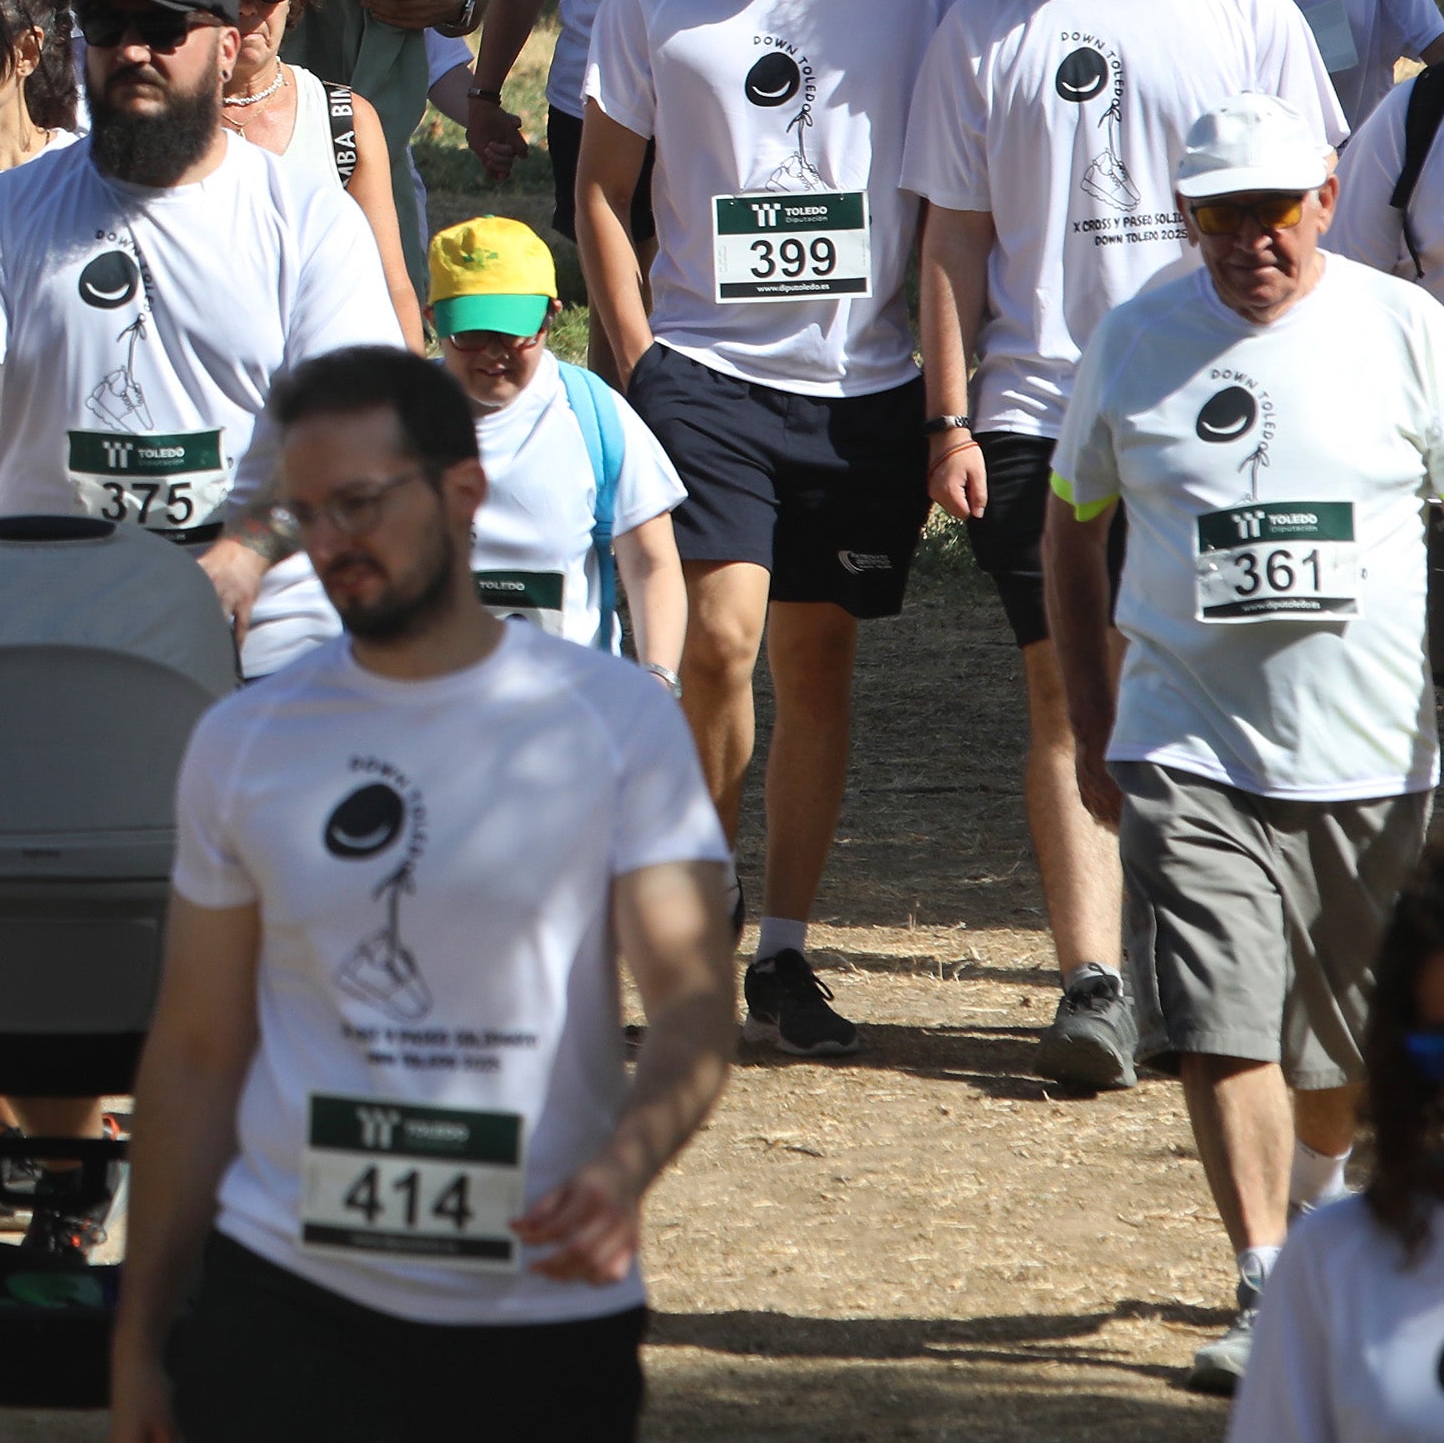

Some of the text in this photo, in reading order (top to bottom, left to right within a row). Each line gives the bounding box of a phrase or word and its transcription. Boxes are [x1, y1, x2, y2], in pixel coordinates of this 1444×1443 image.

[754, 36, 816, 112] DOWN TOLEDO
[1061, 31, 1124, 107] DOWN TOLEDO
[785, 206, 828, 217] TOLEDO
[1074, 221, 1081, 232] X
[1083, 218, 1112, 232] CROSS
[1114, 217, 1123, 228] Y
[1124, 216, 1152, 229] PASEO
[750, 237, 836, 278] 399
[1095, 234, 1123, 246] DOWN
[1126, 231, 1159, 244] TOLEDO
[1212, 368, 1277, 451] DOWN TOLEDO
[138, 447, 185, 459] TOLEDO
[101, 482, 194, 528] 375
[1269, 514, 1318, 525] TOLEDO
[480, 581, 525, 591] TOLEDO
[1235, 549, 1321, 596] 361
[344, 1166, 471, 1229] 414
